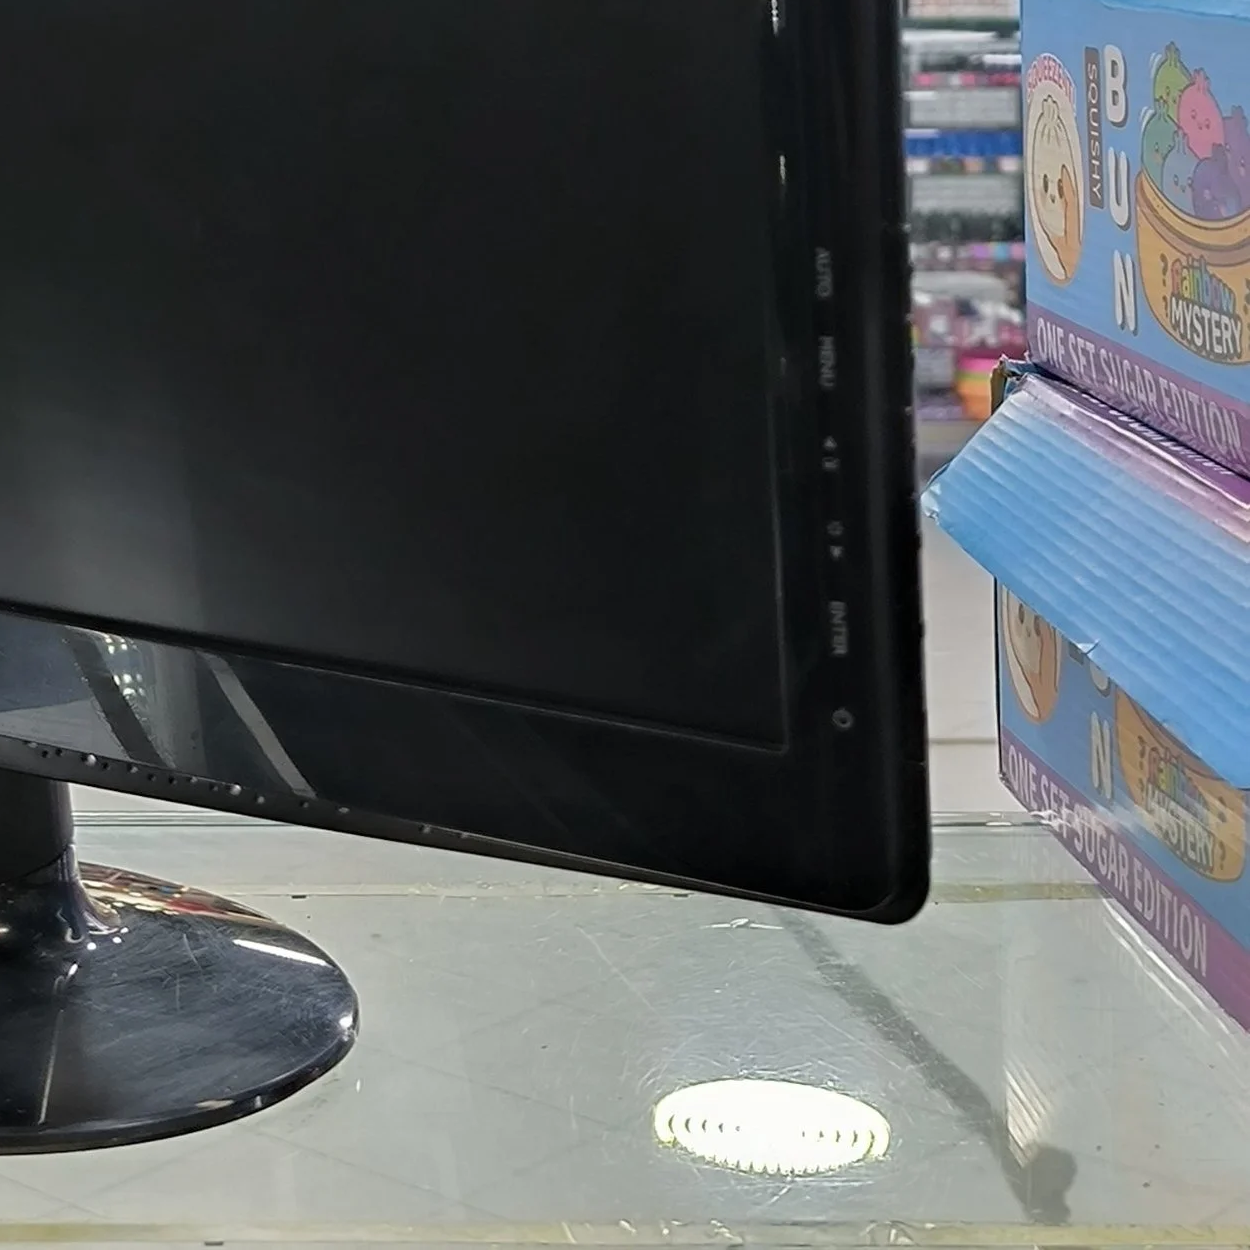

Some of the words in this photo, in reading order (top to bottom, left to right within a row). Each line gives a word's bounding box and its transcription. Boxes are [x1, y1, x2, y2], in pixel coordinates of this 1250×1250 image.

[1087, 63, 1101, 199] SQUISHY
[1037, 317, 1067, 368] ONE
[1068, 332, 1097, 385] SET
[1159, 377, 1246, 462] EDITION
[1171, 296, 1241, 354] MYSTERY
[1008, 744, 1038, 811] ONE
[1040, 774, 1070, 839] SET
[1073, 802, 1130, 900] SUGAR
[1133, 857, 1207, 977] EDITION
